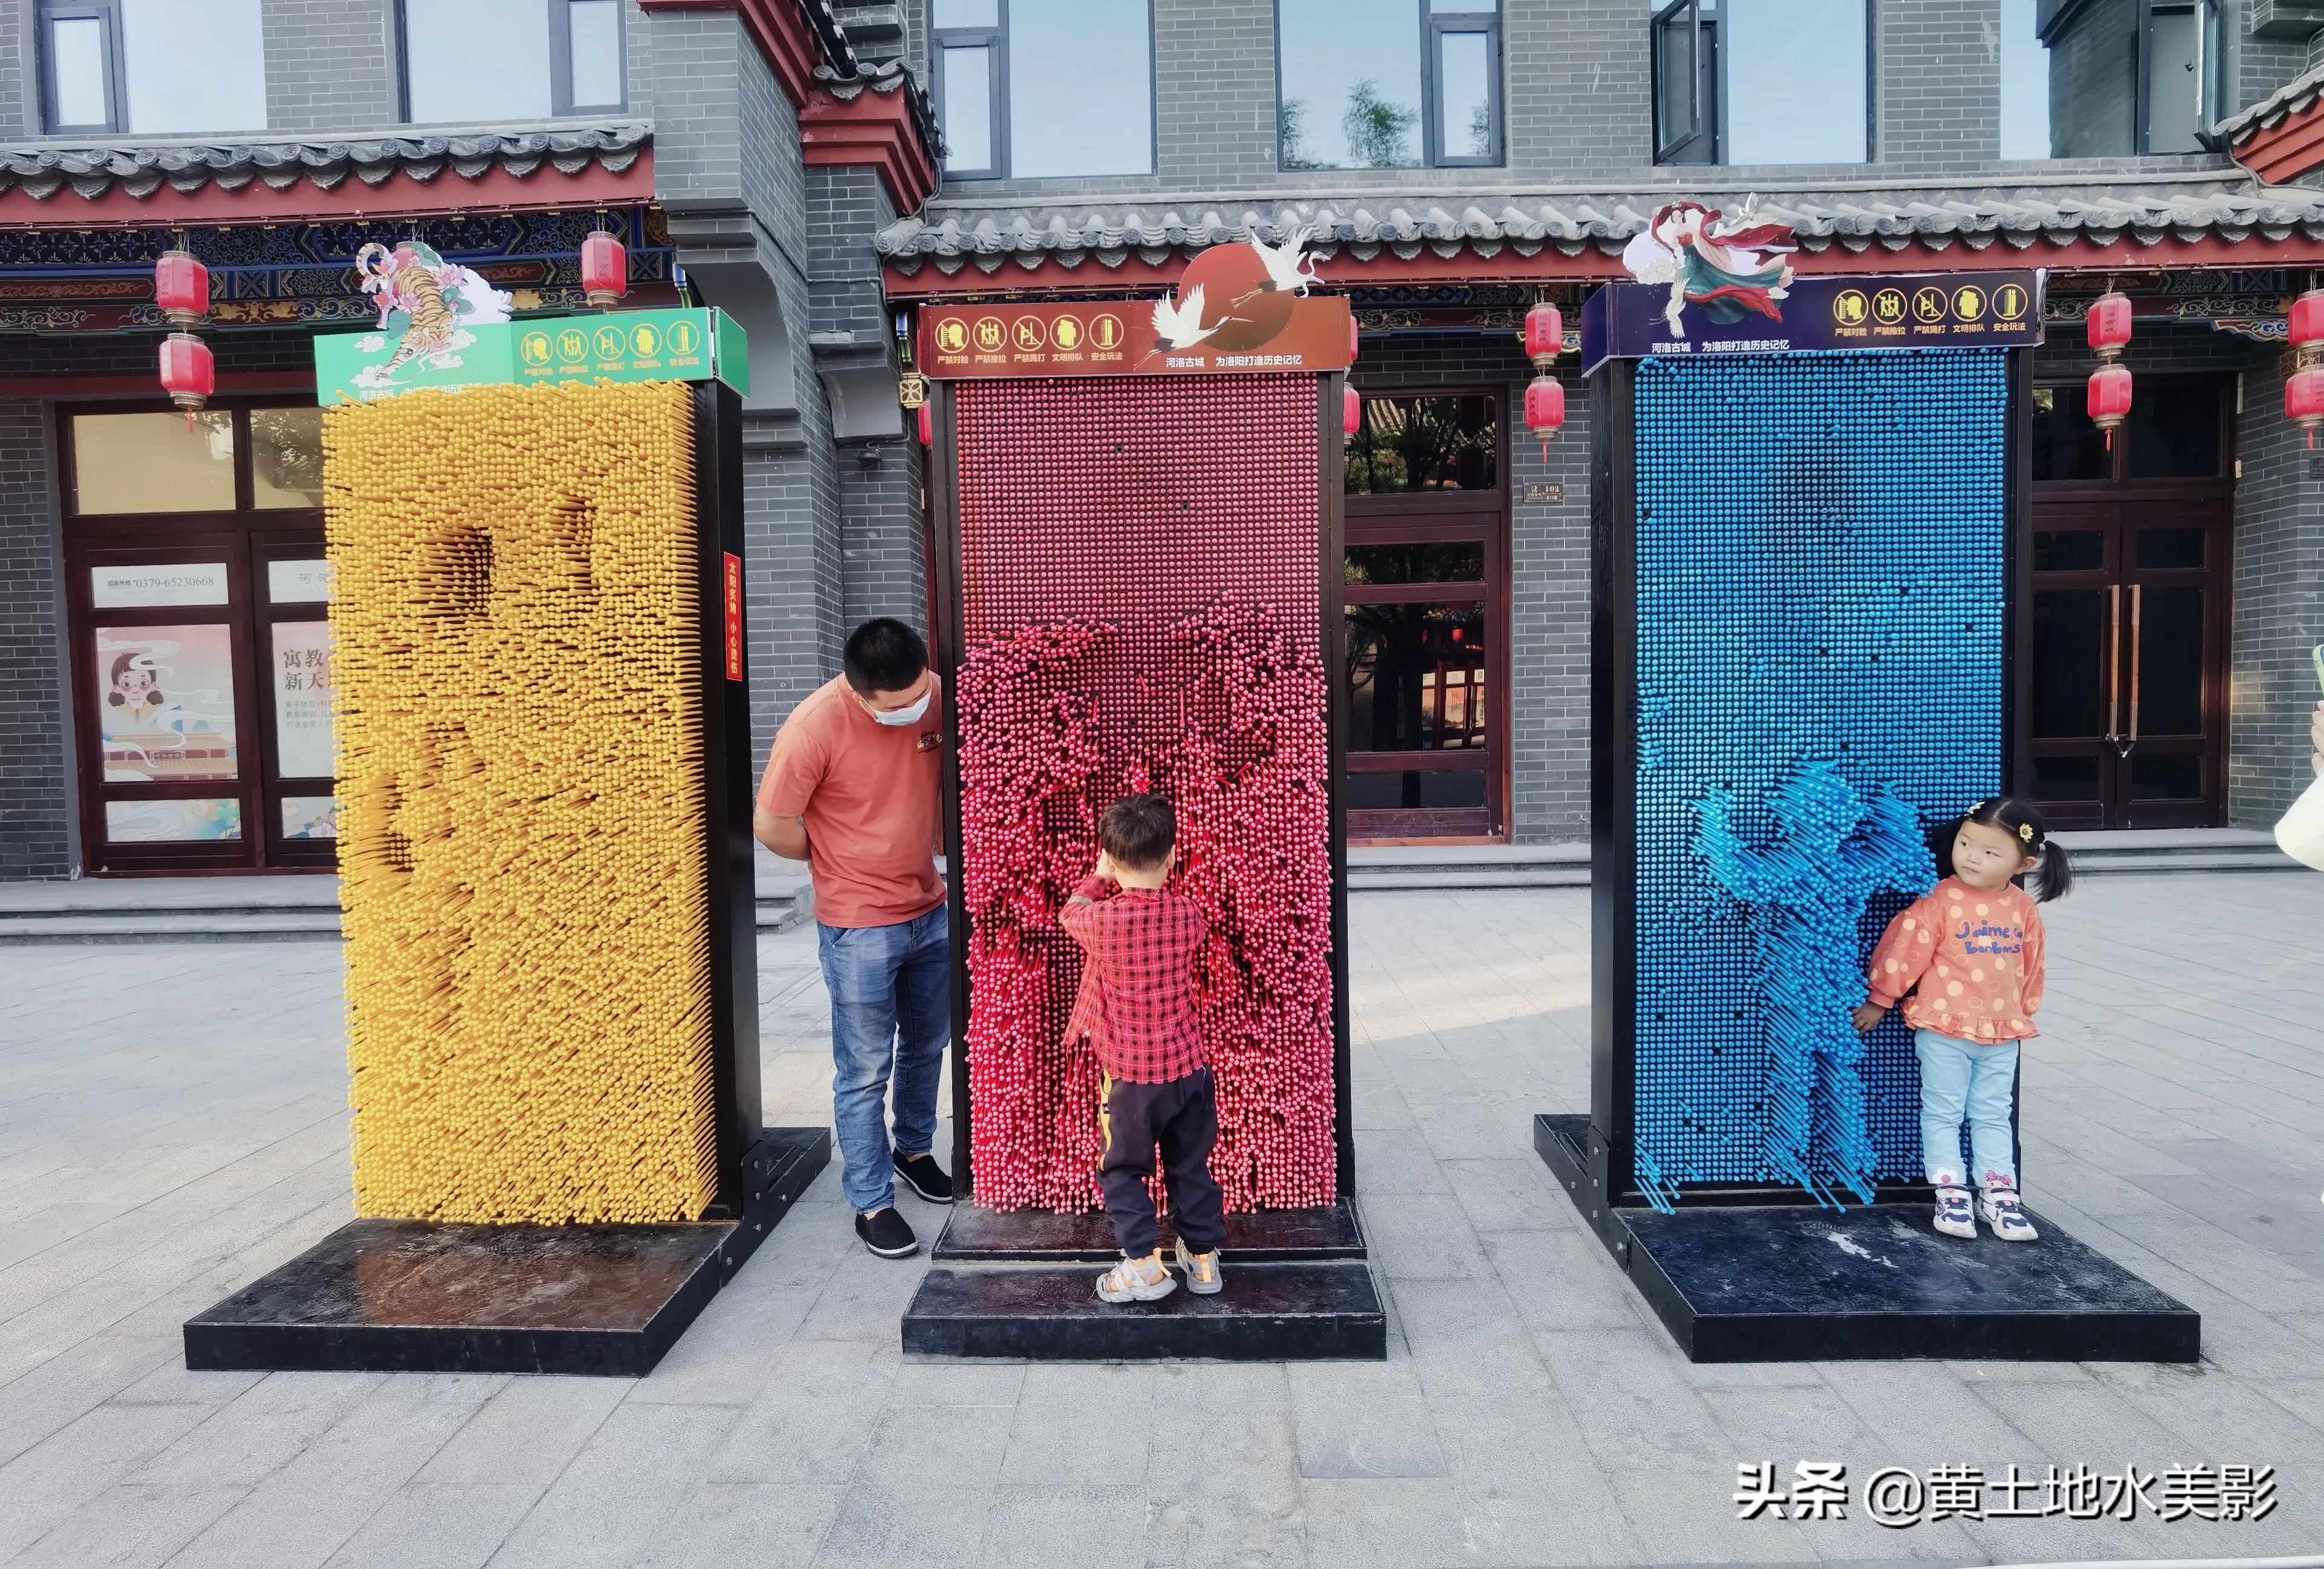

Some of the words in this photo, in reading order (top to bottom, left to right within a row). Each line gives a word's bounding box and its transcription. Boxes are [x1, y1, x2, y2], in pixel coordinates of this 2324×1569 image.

[1952, 323, 1985, 333] 文明排队
[1993, 322, 2026, 331] 安全玩法
[1652, 341, 1692, 353] 河洛古城
[1702, 339, 1790, 352] 为洛阳打造历史记忆
[937, 355, 969, 364] 严禁对脸
[974, 354, 1007, 363] 严禁推拉
[1051, 352, 1084, 361] 文明排队
[1091, 351, 1123, 361] 安全玩法
[1166, 356, 1205, 367] 河洛古城
[1215, 354, 1302, 367] 为洛阳打造历史记忆
[136, 576, 214, 588] 0379-65230668
